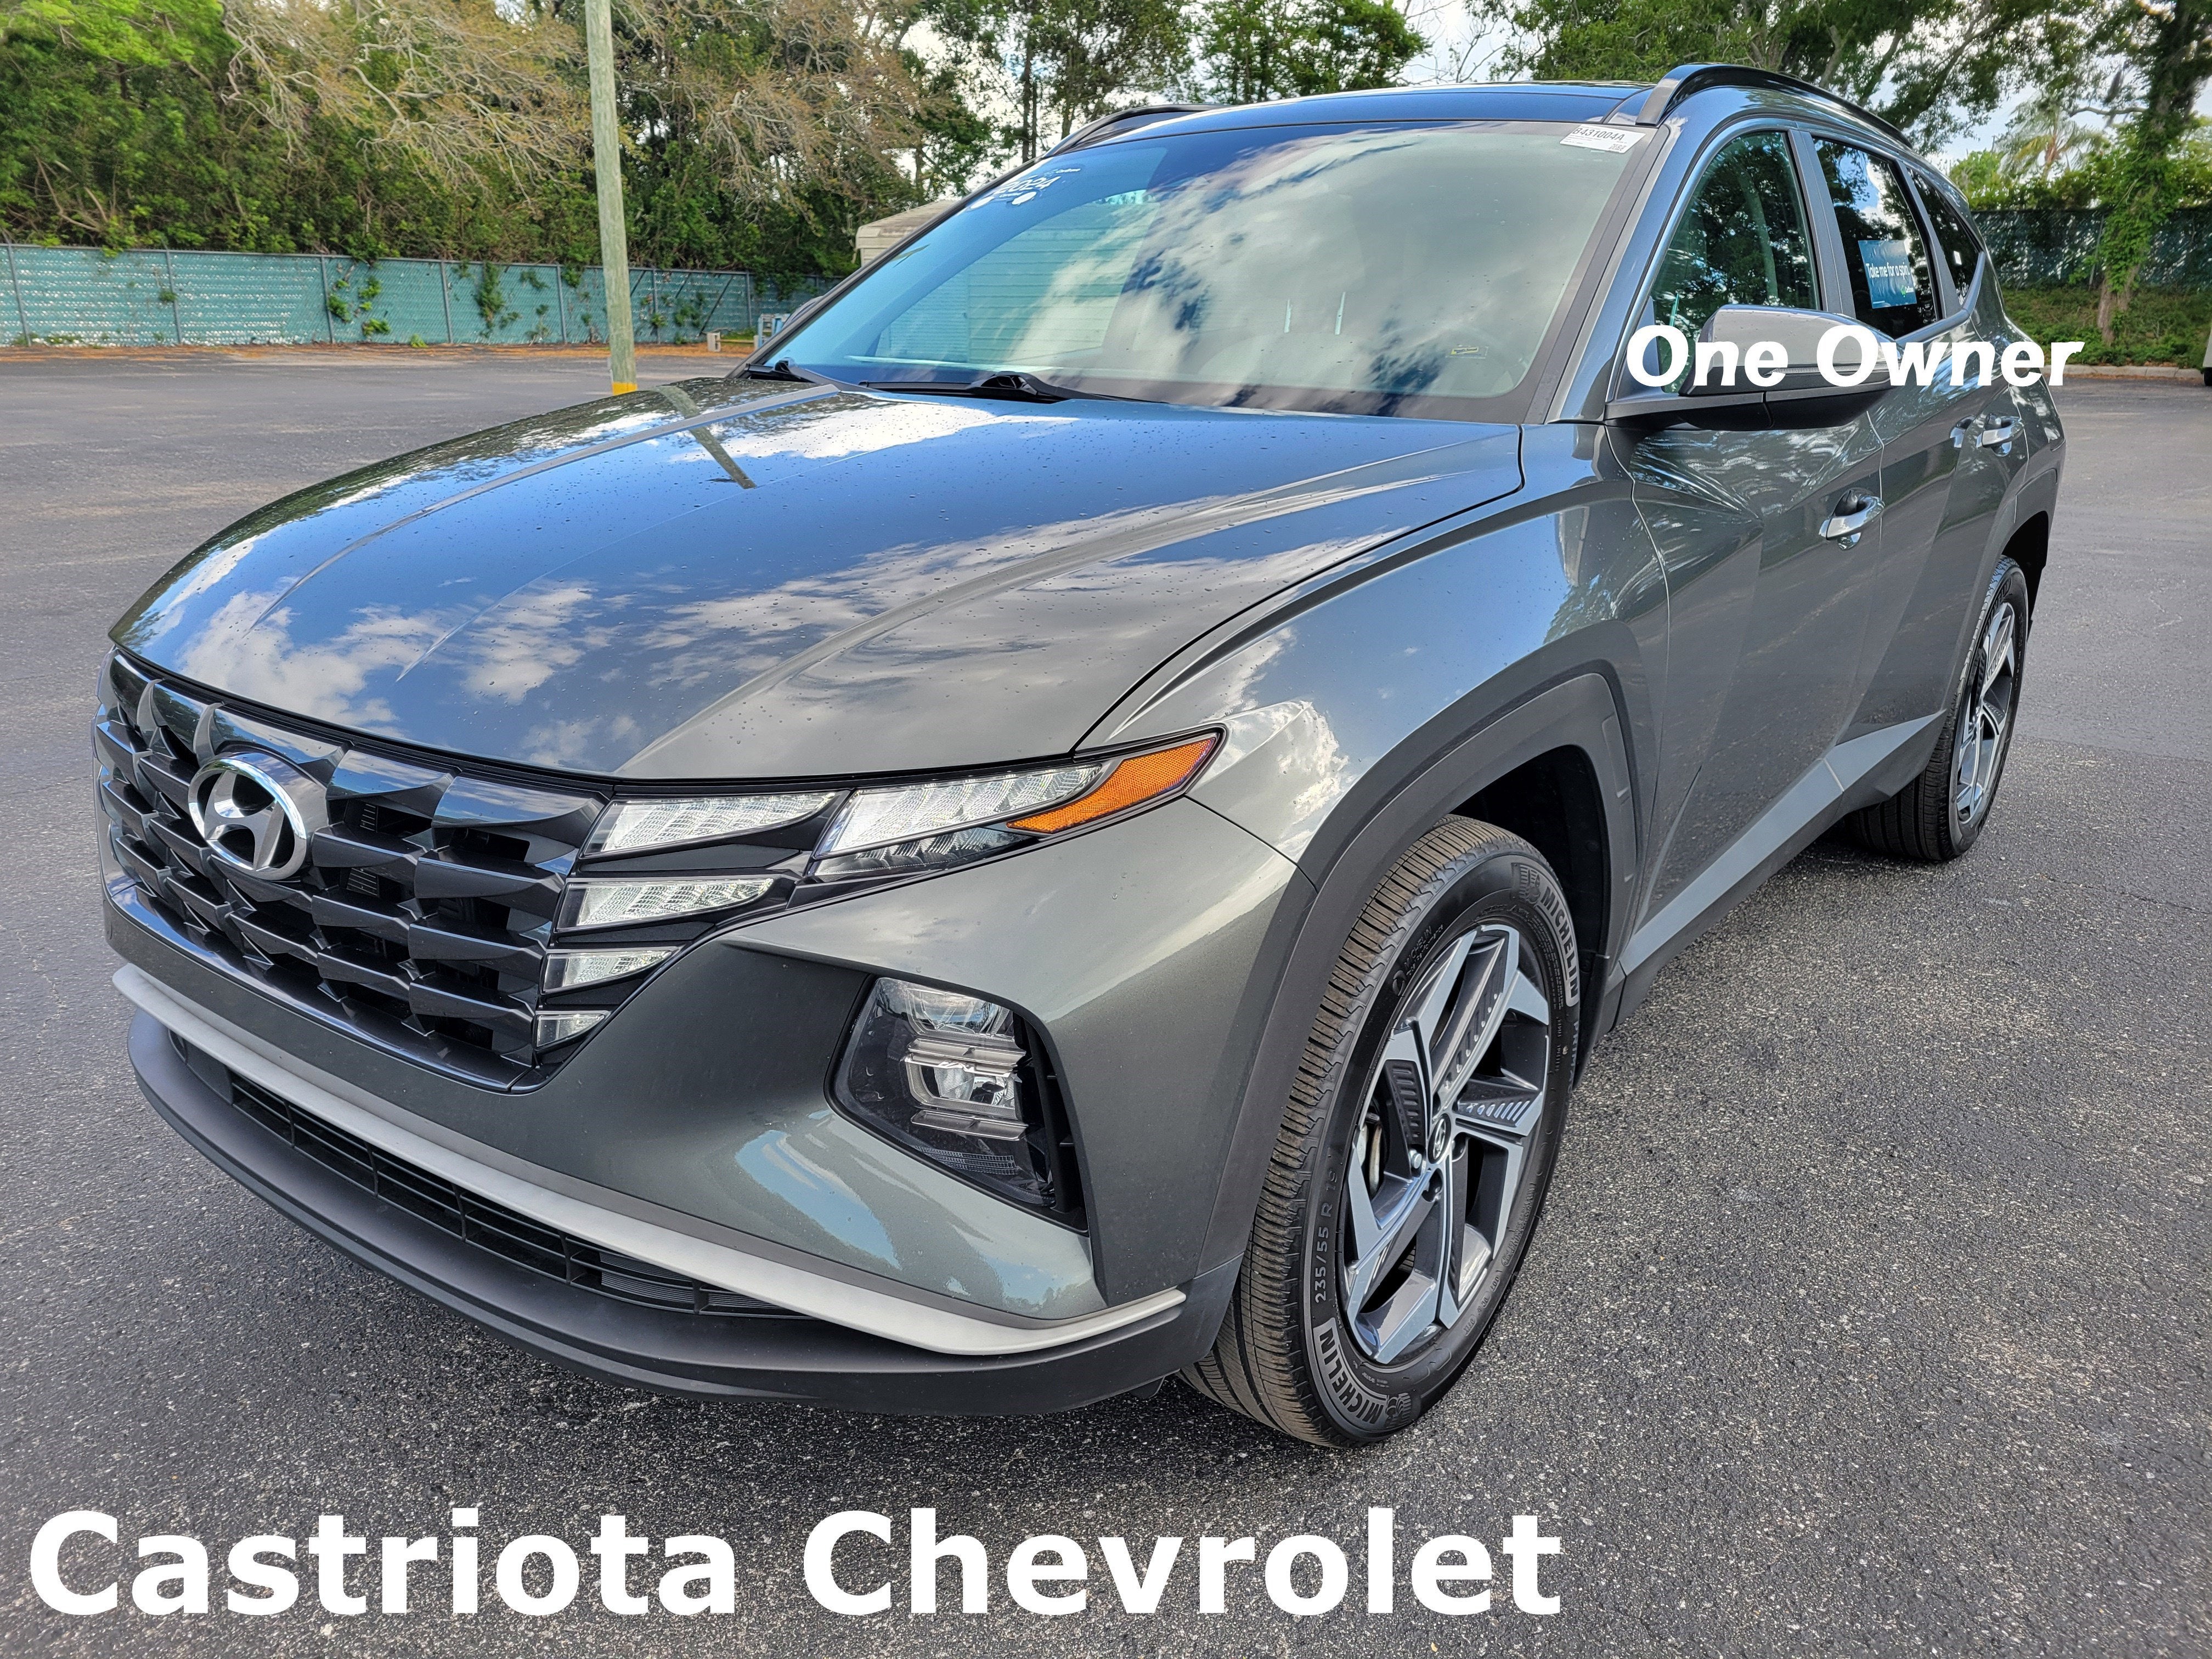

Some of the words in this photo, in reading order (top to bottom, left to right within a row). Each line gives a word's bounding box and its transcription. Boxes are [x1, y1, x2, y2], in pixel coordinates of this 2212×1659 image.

[1572, 127, 1626, 141] B431004A
[1865, 263, 1880, 278] Take
[1878, 266, 1888, 277] me
[1887, 262, 1895, 276] for
[1894, 265, 1900, 276] a
[1541, 886, 1578, 998] MICHELIN
[1321, 1202, 1333, 1217] R
[1314, 1227, 1329, 1304] 235/55
[1319, 1327, 1384, 1425] MICHELIN
